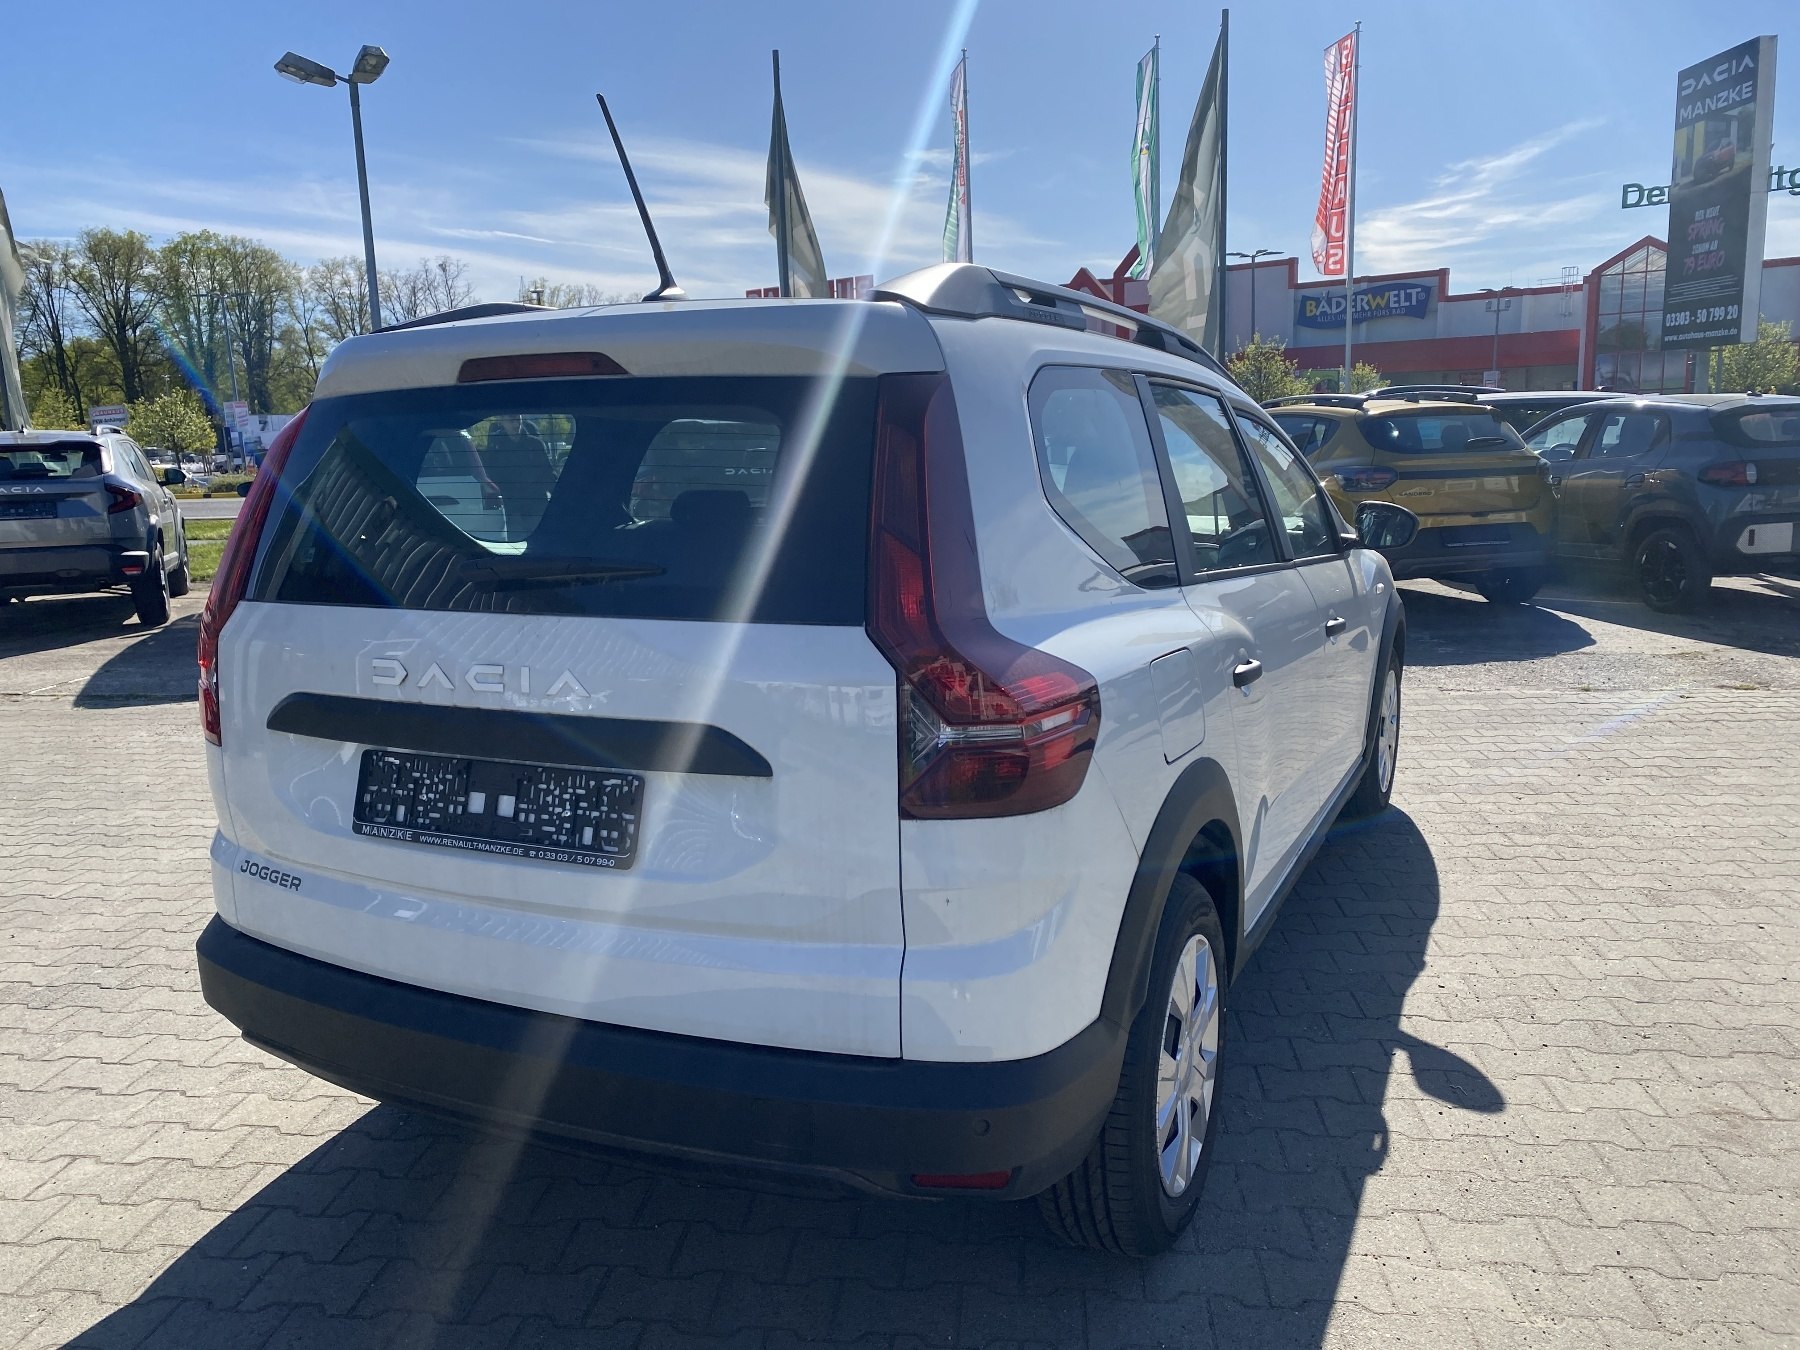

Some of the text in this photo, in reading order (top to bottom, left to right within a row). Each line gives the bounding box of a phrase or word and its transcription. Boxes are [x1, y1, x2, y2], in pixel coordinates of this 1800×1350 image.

[1682, 54, 1755, 97] DACIA
[1679, 80, 1754, 123] MANZKE
[1622, 183, 1671, 209] De
[1688, 217, 1725, 241] SPRING
[1683, 250, 1725, 276] 79 EURO
[1353, 311, 1372, 319] MEHR
[1665, 311, 1690, 327] 03303
[1696, 308, 1708, 323] 50
[1709, 306, 1725, 321] 799
[1726, 304, 1739, 320] 20
[1664, 328, 1738, 342] www.autohaus-manzke.de
[372, 658, 591, 698] DACIA
[419, 835, 525, 856] WWW.RENAULT-MANZKE.DE
[240, 860, 302, 891] JOGGER
